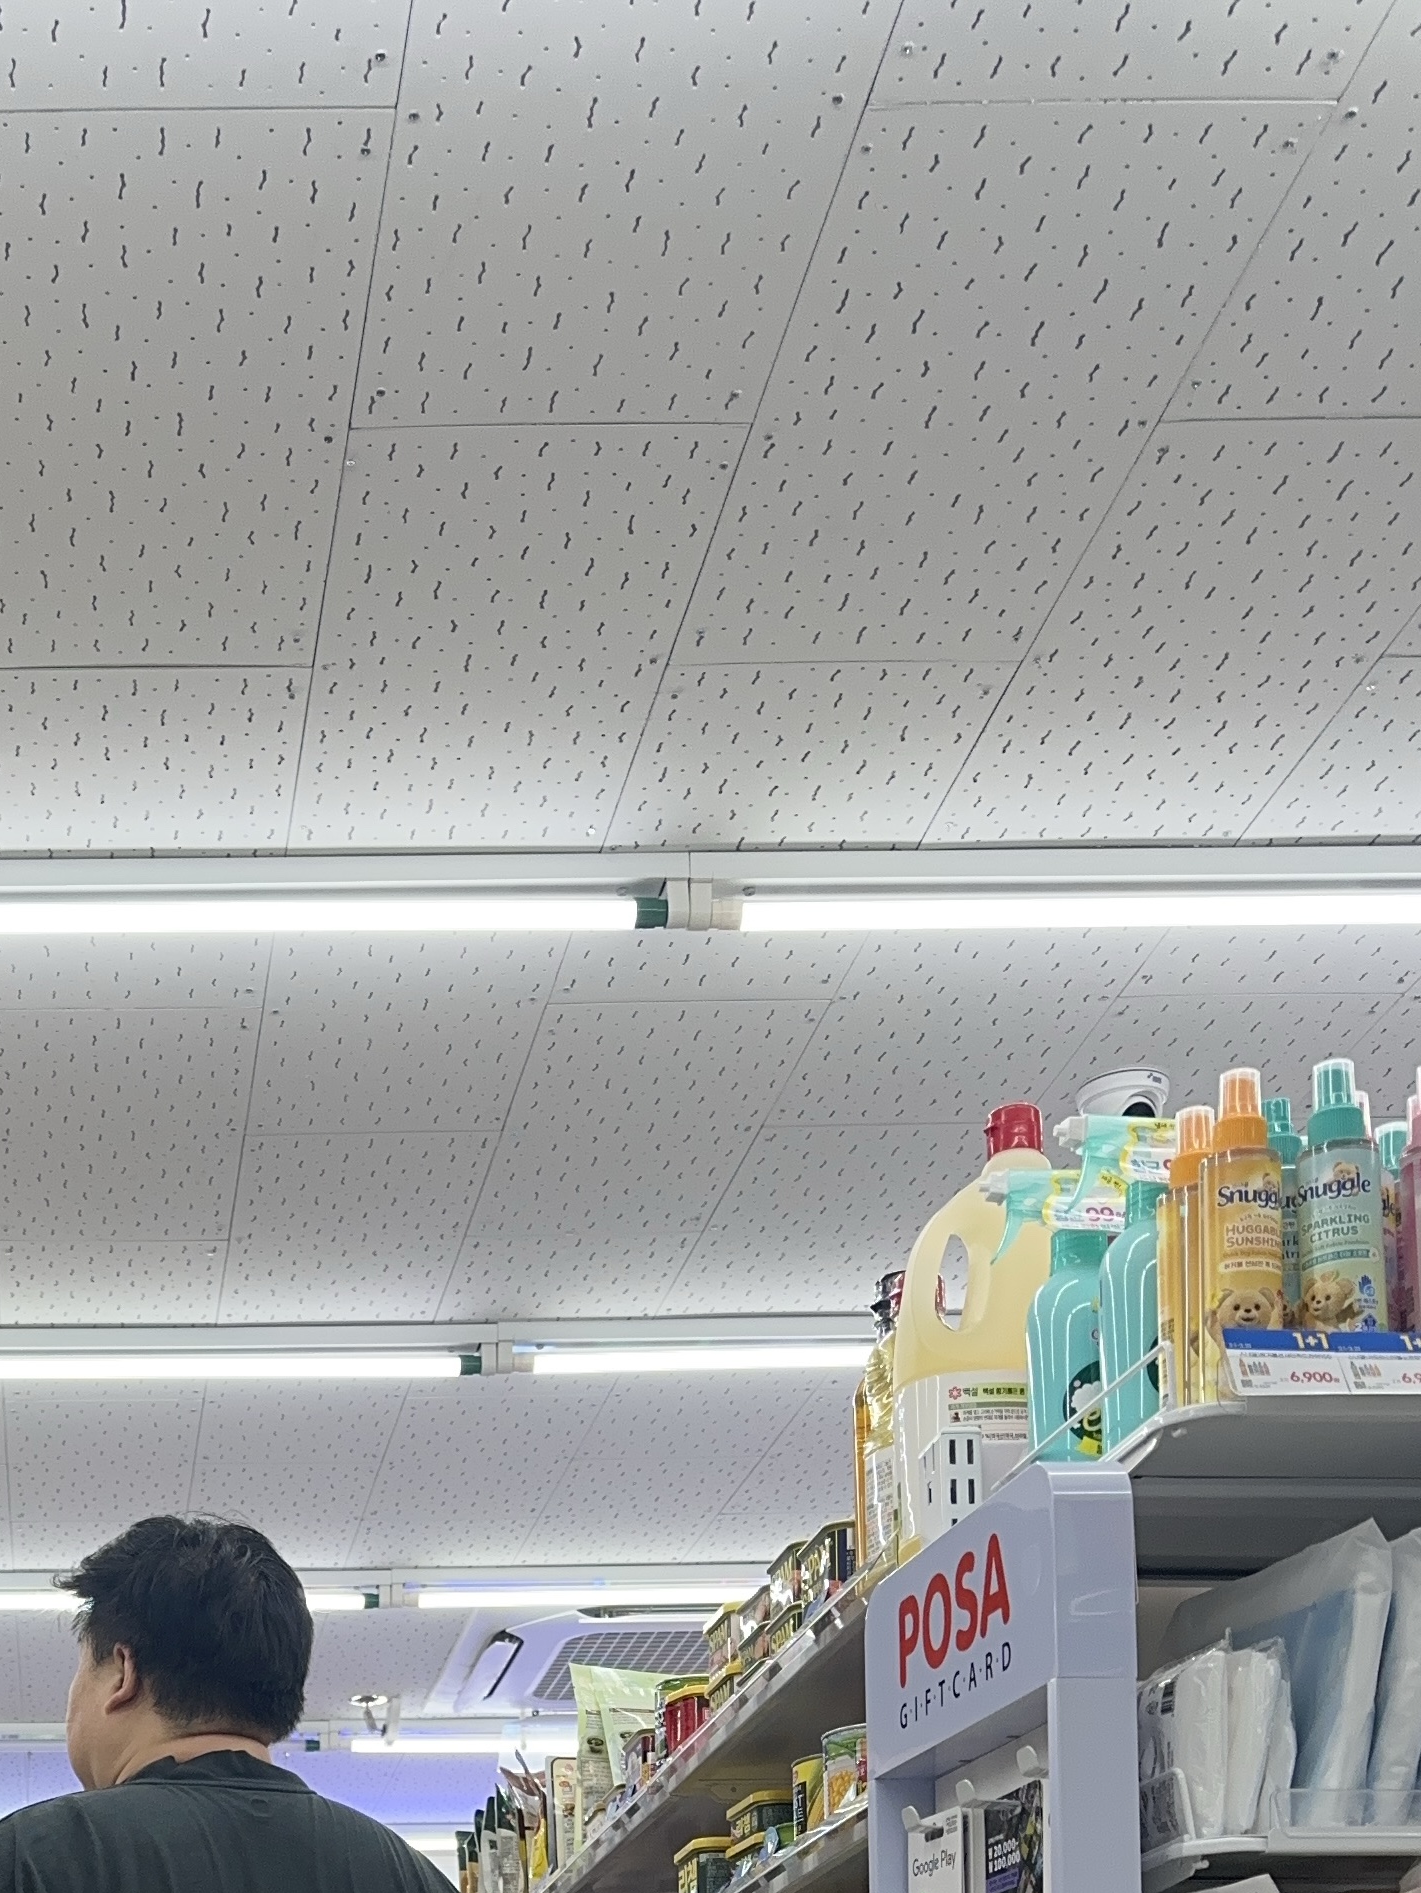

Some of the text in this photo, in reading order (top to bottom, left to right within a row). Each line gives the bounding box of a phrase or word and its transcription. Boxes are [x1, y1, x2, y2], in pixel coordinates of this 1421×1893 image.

[1300, 1213, 1370, 1237] SPARKLING
[1309, 1226, 1359, 1244] CITRUS
[1292, 1332, 1330, 1350] 1+1
[897, 1533, 1013, 1689] POSA
[912, 1850, 958, 1878] Google Play
